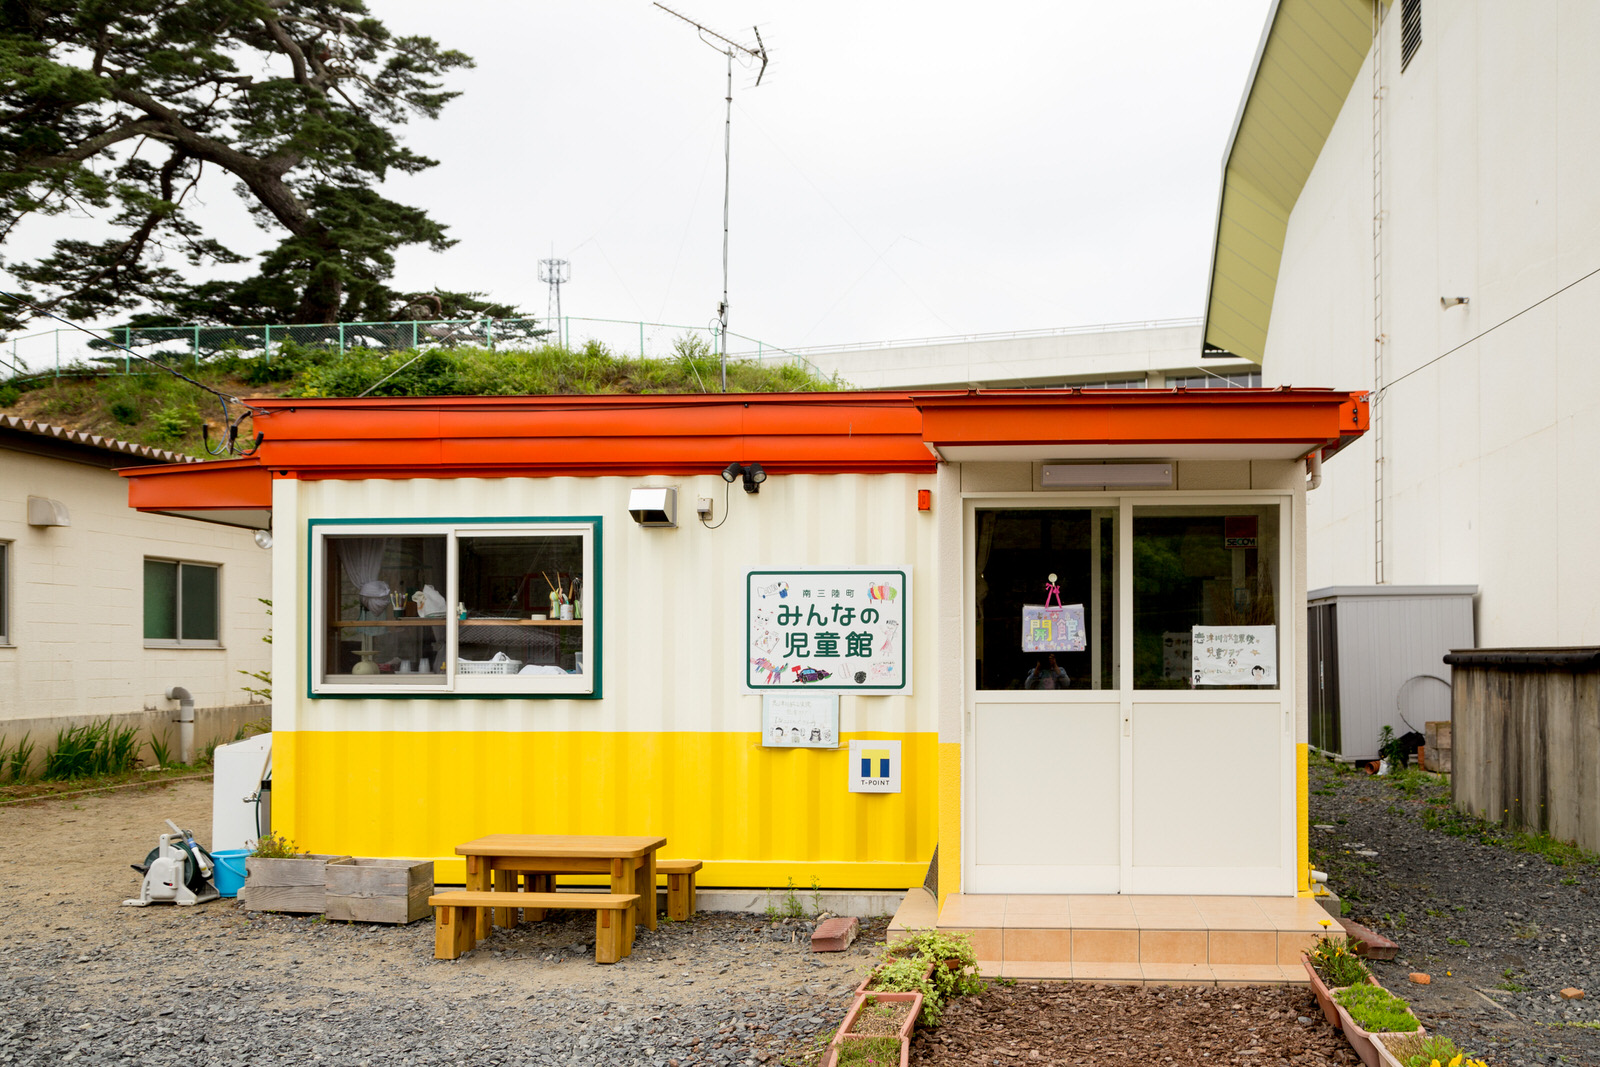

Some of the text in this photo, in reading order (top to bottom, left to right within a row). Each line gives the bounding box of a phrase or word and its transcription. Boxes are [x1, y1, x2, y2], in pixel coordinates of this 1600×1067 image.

[1227, 538, 1255, 546] SECOM
[802, 589, 855, 598] 南三陸町
[777, 603, 880, 627] みんなの
[1030, 618, 1078, 642] 開館
[783, 631, 874, 659] 児童館
